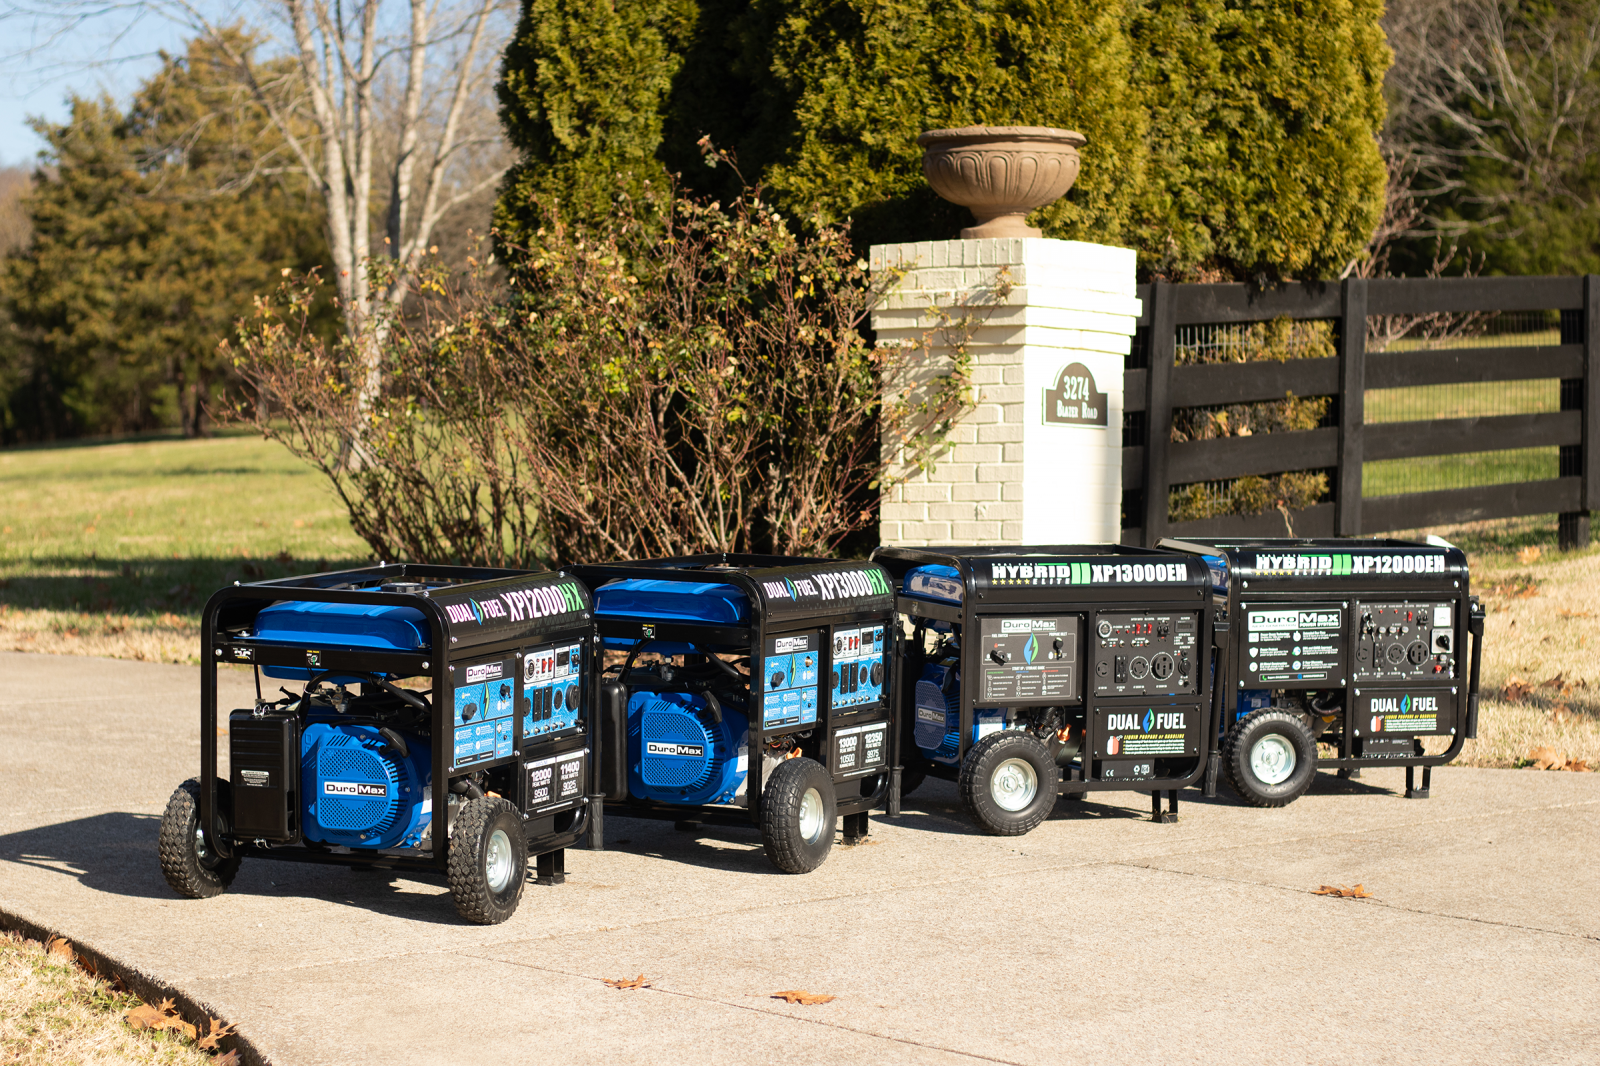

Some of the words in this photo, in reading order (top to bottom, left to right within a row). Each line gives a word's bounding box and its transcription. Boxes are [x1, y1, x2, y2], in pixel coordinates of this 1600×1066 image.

[1063, 375, 1090, 401] 3274
[1082, 402, 1098, 420] ROAD
[1256, 556, 1332, 569] HYBRID
[1352, 555, 1444, 574] XP12000EH
[992, 566, 1070, 578] HYBRID
[1092, 564, 1188, 582] XP13000EH
[763, 582, 790, 598] DUAL
[796, 580, 818, 596] FUEL
[812, 568, 890, 601] XP13000HX
[445, 603, 476, 624] DUAL
[479, 599, 507, 619] FUEL
[500, 582, 585, 622] XP12000HX
[1370, 698, 1399, 713] DUAL
[1412, 697, 1438, 712] FUEL
[1107, 714, 1140, 730] DUAL
[1156, 713, 1186, 729] FUEL
[839, 736, 857, 748] 13000
[865, 732, 882, 744] 12350
[649, 744, 702, 755] DuroMax
[840, 753, 855, 763] 10500
[560, 760, 580, 775] 11400
[531, 768, 552, 782] 12000
[326, 784, 385, 794] DuroMax
[534, 787, 548, 798] 9500
[563, 780, 577, 791] 9025
